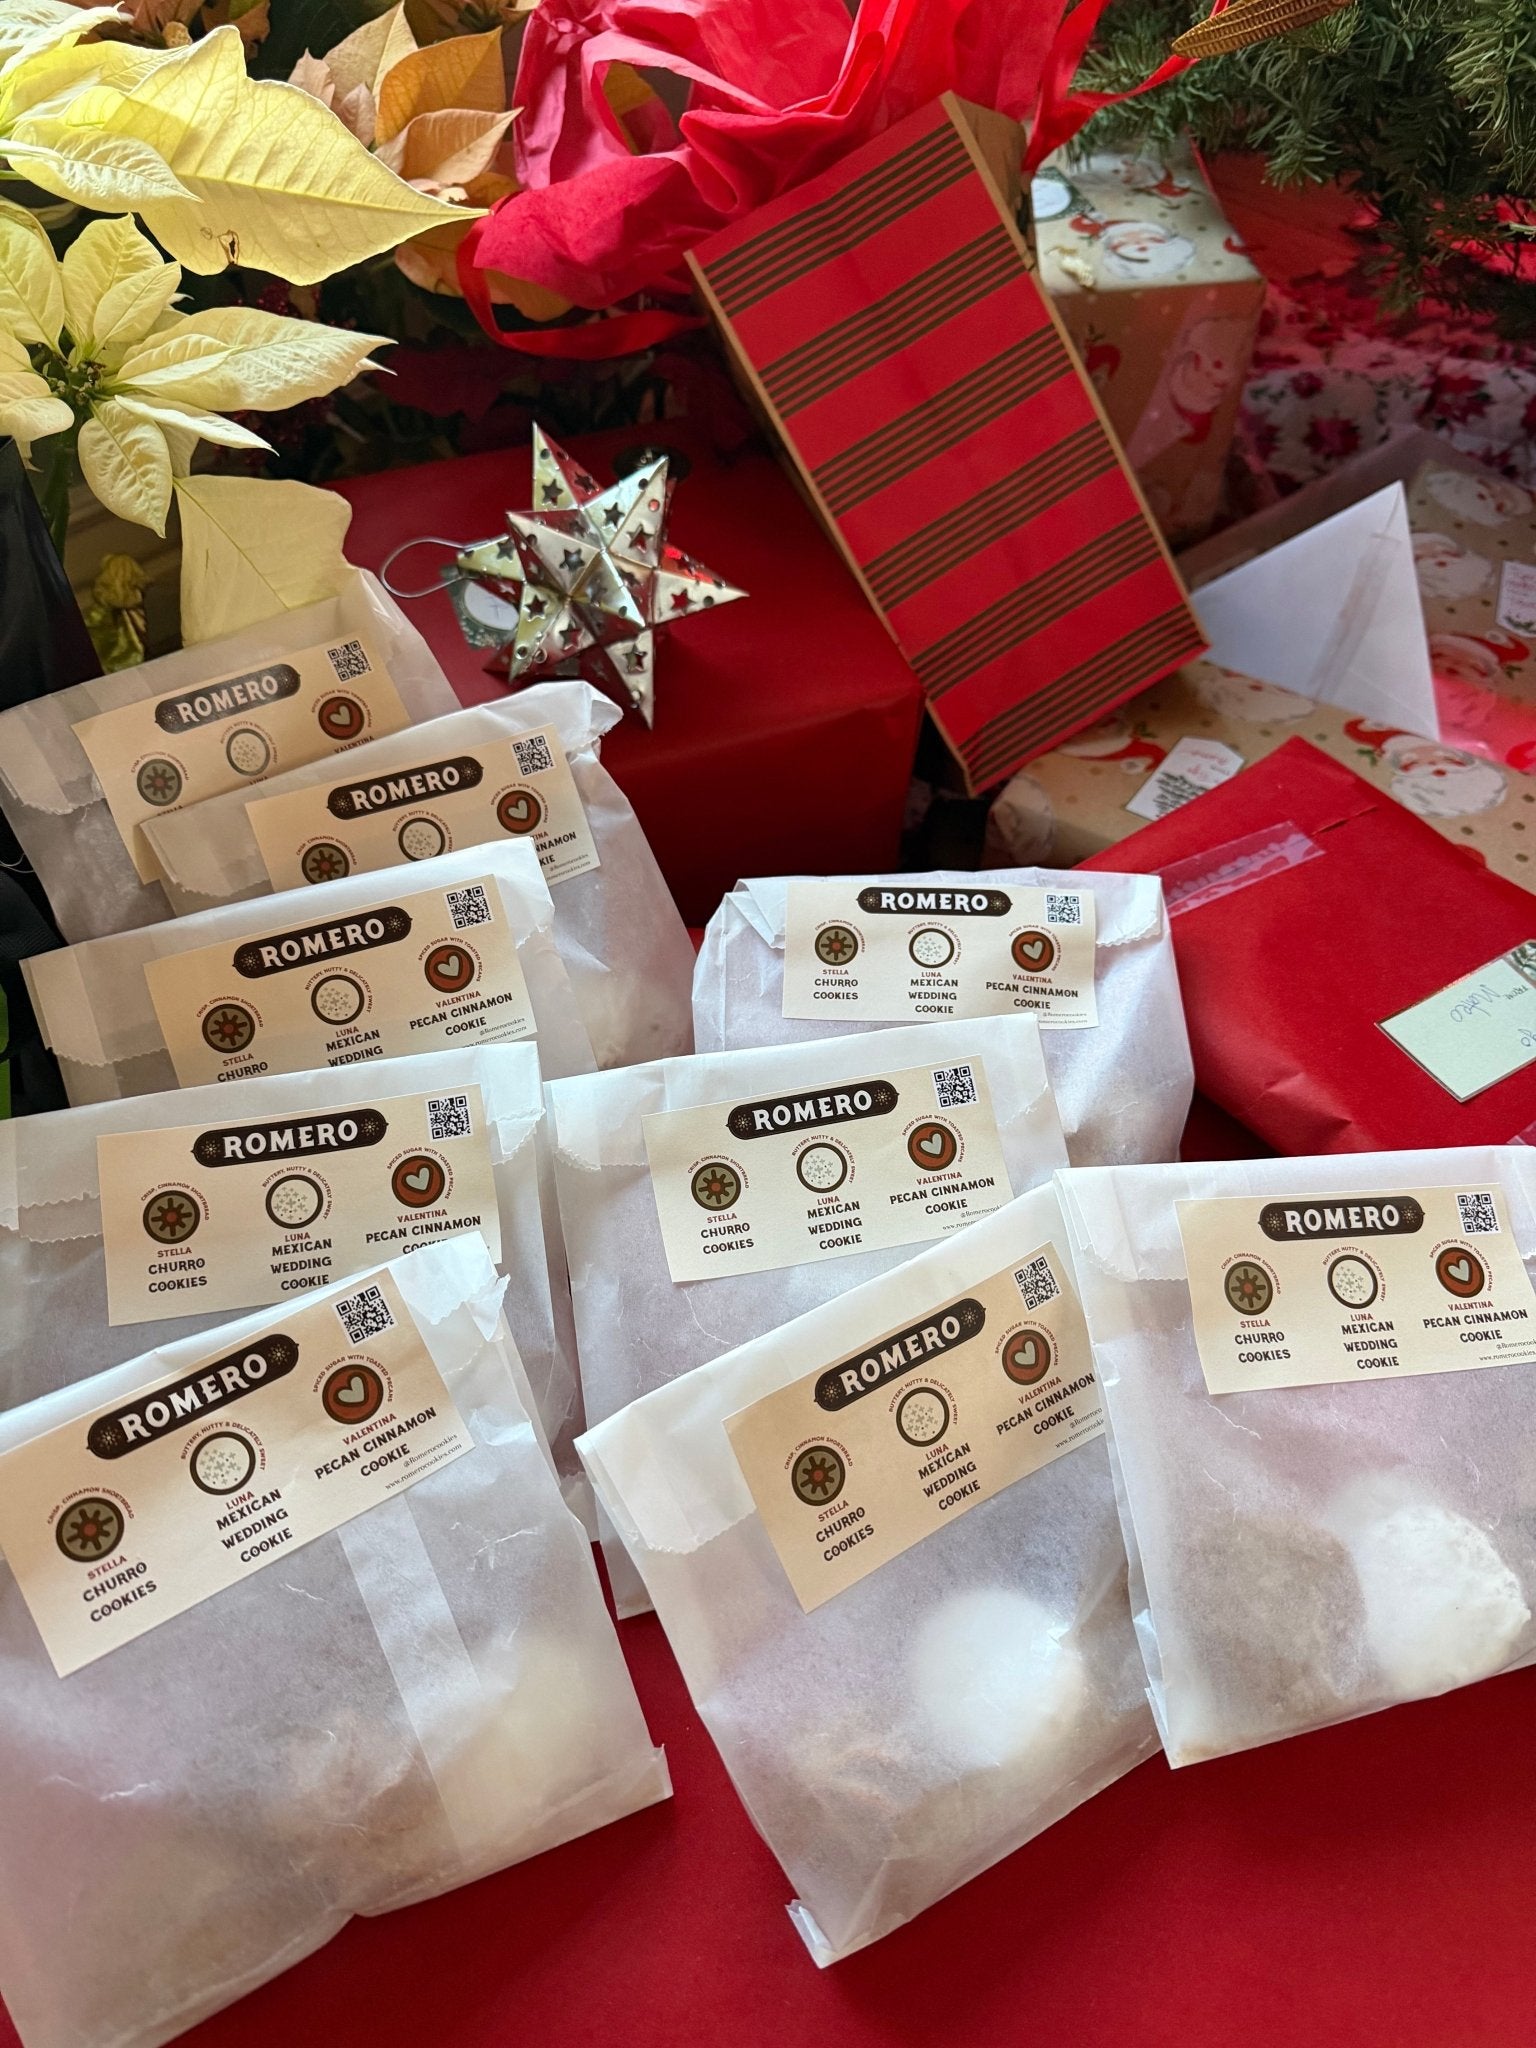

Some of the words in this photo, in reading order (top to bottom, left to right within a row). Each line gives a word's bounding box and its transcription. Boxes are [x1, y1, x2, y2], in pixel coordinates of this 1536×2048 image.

[176, 676, 278, 723] ROMERO
[350, 766, 460, 810] ROMERO
[880, 892, 988, 913] ROMERO
[259, 918, 386, 968] ROMERO
[815, 978, 858, 987] CHURRO
[910, 979, 958, 987] MEXICAN
[1013, 974, 1052, 984] VALENTINA
[436, 991, 481, 1008] VALENTINA
[814, 992, 858, 1000] COOKIES
[908, 992, 957, 1000] WEDDING
[986, 982, 1019, 992] PECAN
[1023, 986, 1078, 998] CINNAMON
[410, 1012, 447, 1030] PECAN
[451, 993, 512, 1017] CINNAMON
[915, 1005, 953, 1013] COOKIE
[1014, 999, 1050, 1009] COOKIE
[336, 1026, 359, 1038] LUNA
[445, 1017, 486, 1036] COOKIE
[326, 1030, 380, 1052] MEXICAN
[223, 1053, 254, 1066] STELLA
[328, 1046, 383, 1067] WEDDING
[218, 1062, 268, 1082] CHURRO
[752, 1090, 872, 1131] ROMERO
[902, 1120, 914, 1136] SPICED
[916, 1114, 932, 1122] SUGAR
[948, 1120, 963, 1141] TOASTED
[222, 1119, 358, 1160] ROMERO
[387, 1153, 402, 1170] SPICED
[403, 1147, 422, 1155] SUGAR
[834, 1139, 855, 1163] DELICATELY
[438, 1154, 453, 1176] TOASTED
[445, 1177, 453, 1199] PECANS
[917, 1172, 962, 1185] VALENTINA
[313, 1171, 332, 1198] DELICATELY
[323, 1200, 332, 1220] SWEET
[817, 1196, 840, 1205] LUNA
[890, 1190, 928, 1204] PECAN
[932, 1177, 994, 1196] CINNAMON
[191, 1187, 209, 1221] SHORTBREAD
[807, 1201, 860, 1219] MEXICAN
[926, 1199, 967, 1214] COOKIE
[397, 1209, 448, 1223] VALENTINA
[707, 1213, 737, 1223] STELLA
[808, 1218, 862, 1235] WEDDING
[1284, 1204, 1399, 1234] ROMERO
[285, 1232, 310, 1242] LUNA
[366, 1228, 407, 1243] PECAN
[412, 1216, 481, 1235] CINNAMON
[701, 1223, 750, 1238] CHURRO
[272, 1239, 332, 1256] MEXICAN
[703, 1239, 754, 1254] COOKIES
[820, 1234, 862, 1249] COOKIE
[158, 1247, 192, 1258] STELLA
[148, 1258, 205, 1275] CHURRO
[270, 1257, 332, 1274] WEDDING
[148, 1276, 208, 1293] COOKIES
[281, 1274, 329, 1290] COOKIE
[1448, 1301, 1493, 1311] VALENTINA
[1240, 1320, 1270, 1328] STELLA
[1350, 1313, 1373, 1321] LUNA
[1423, 1316, 1460, 1328] PECAN
[1464, 1309, 1528, 1324] CINNAMON
[995, 1334, 1005, 1354] SPICED
[1005, 1321, 1022, 1334] SUGAR
[1038, 1323, 1055, 1342] TOASTED
[1235, 1332, 1284, 1344] CHURRO
[1342, 1321, 1394, 1335] MEXICAN
[1460, 1330, 1502, 1342] COOKIE
[838, 1316, 960, 1396] ROMERO
[1344, 1339, 1398, 1352] WEDDING
[1239, 1350, 1291, 1363] COOKIES
[1357, 1357, 1399, 1369] COOKIE
[313, 1371, 325, 1393] SPICED
[325, 1357, 346, 1371] SUGAR
[366, 1356, 388, 1375] TOASTED
[118, 1354, 267, 1443] ROMERO
[905, 1378, 922, 1389] NUTTY
[930, 1378, 955, 1402] DELICATELY
[1018, 1377, 1062, 1404] VALENTINA
[996, 1408, 1033, 1435] PECAN
[1035, 1373, 1095, 1413] CINNAMON
[342, 1414, 397, 1445] VALENTINA
[1034, 1406, 1074, 1435] COOKIE
[202, 1422, 224, 1433] NUTTY
[232, 1422, 262, 1446] DELICATELY
[314, 1448, 360, 1479] PECAN
[363, 1407, 437, 1452] CINNAMON
[360, 1444, 410, 1477] COOKIE
[404, 1434, 457, 1468] @Romerocookies
[795, 1436, 824, 1451] CINNAMON
[826, 1437, 853, 1467] SHORTBREAD
[918, 1442, 971, 1480] MEXICAN
[925, 1444, 949, 1461] LUNA
[922, 1461, 977, 1498] WEDDING
[62, 1487, 100, 1504] CINNAMON
[102, 1488, 134, 1519] SHORTBREAD
[226, 1491, 255, 1510] LUNA
[939, 1480, 980, 1511] COOKIE
[216, 1489, 281, 1530] MEXICAN
[818, 1500, 849, 1522] STELLA
[221, 1508, 288, 1549] WEDDING
[816, 1507, 865, 1542] CHURRO
[240, 1527, 292, 1562] COOKIE
[824, 1524, 874, 1561] COOKIES
[88, 1555, 127, 1579] STELLA
[83, 1562, 147, 1602] CHURRO
[90, 1580, 157, 1622] COOKIES
